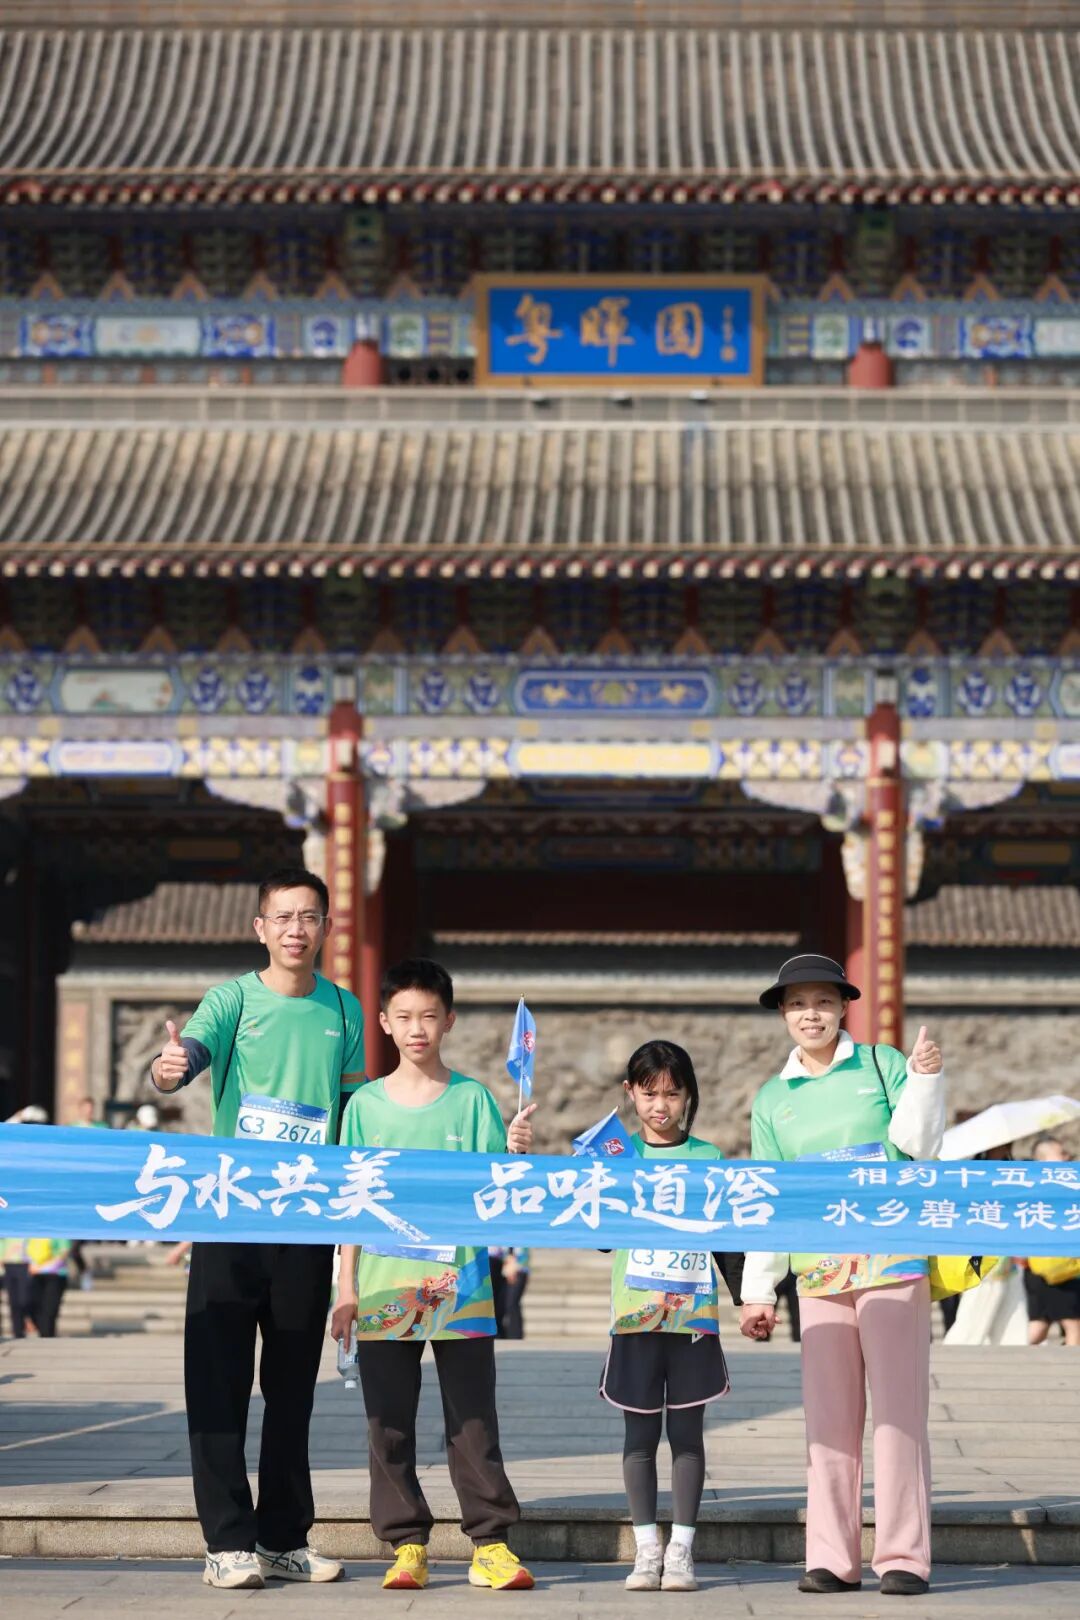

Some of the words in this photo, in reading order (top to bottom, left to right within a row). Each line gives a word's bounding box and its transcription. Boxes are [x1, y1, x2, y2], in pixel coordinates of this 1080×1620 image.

[239, 1115, 265, 1135] C3
[276, 1121, 321, 1144] 2674
[848, 1166, 1080, 1190] 相约十五运
[95, 1143, 431, 1242] 与水共美
[473, 1161, 780, 1233] 品味道滘
[631, 1248, 655, 1266] C3
[667, 1251, 707, 1271] 2673
